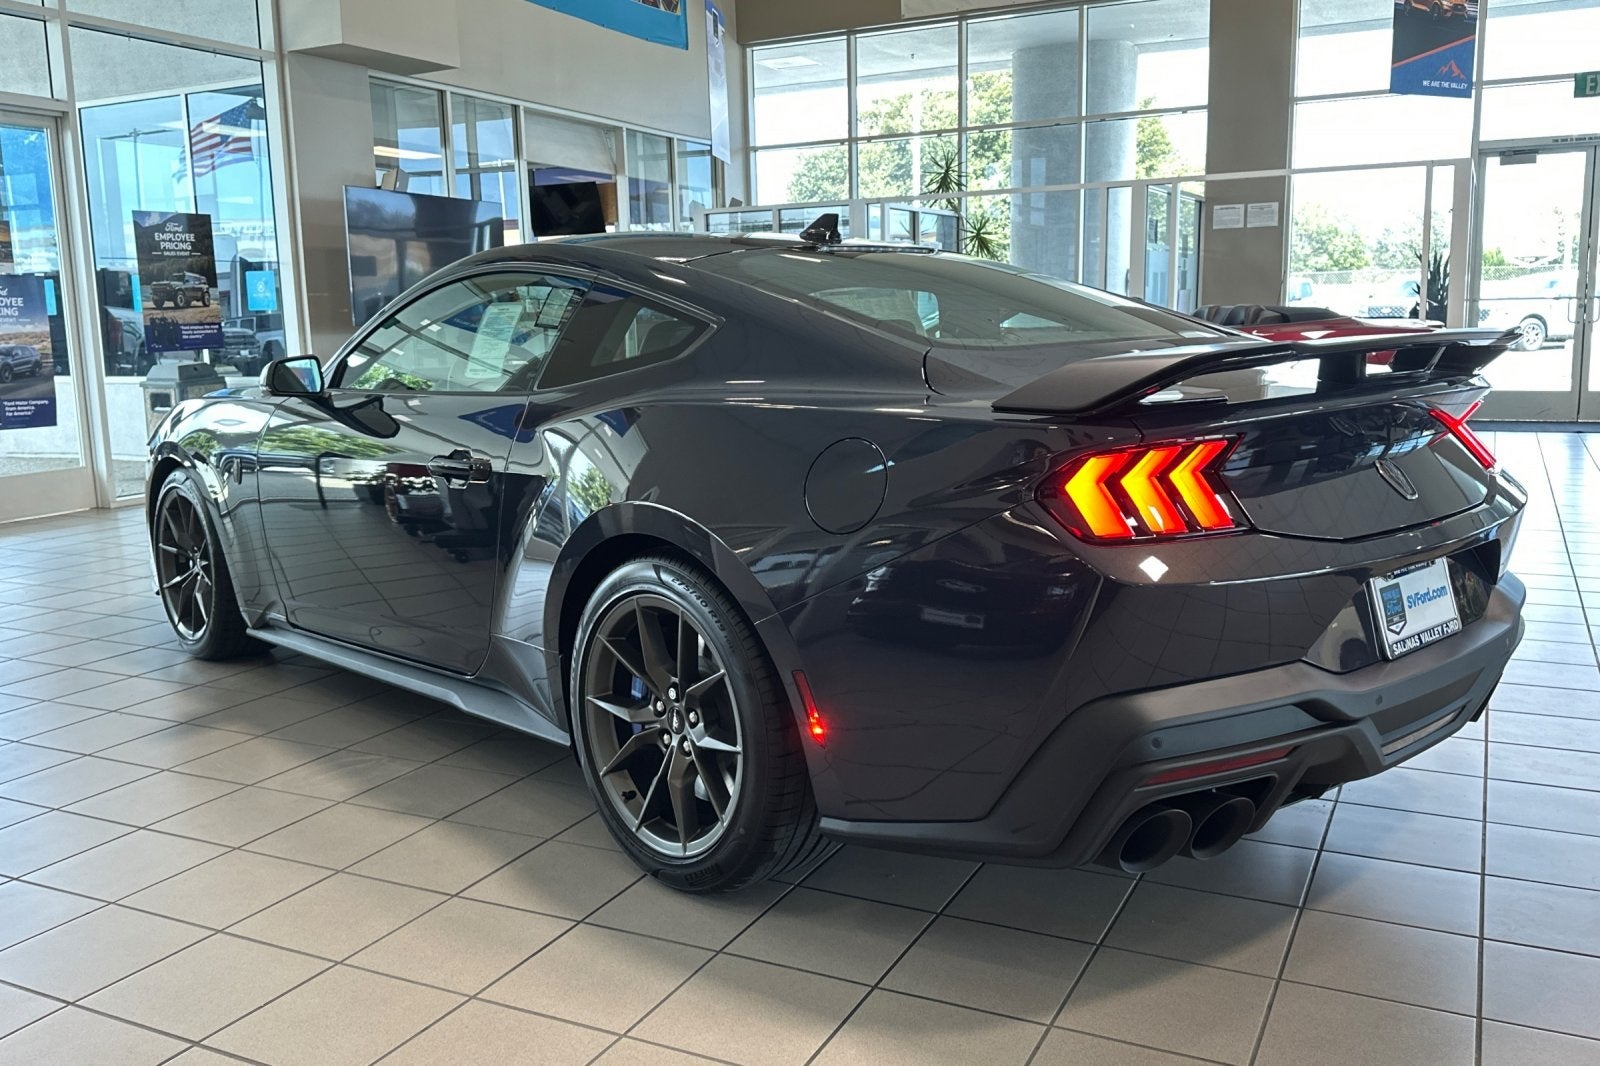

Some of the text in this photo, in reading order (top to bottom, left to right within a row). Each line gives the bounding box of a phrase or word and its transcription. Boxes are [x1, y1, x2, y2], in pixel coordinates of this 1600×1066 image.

[1430, 80, 1440, 88] ARE
[1450, 82, 1468, 90] VALLEY
[165, 222, 183, 232] Ford
[154, 232, 195, 242] EMPLOYEE
[160, 241, 192, 251] PRICING
[0, 307, 18, 316] ING
[671, 577, 708, 608] 275/40
[1406, 585, 1448, 609] SVFord.com
[1392, 634, 1420, 655] SALINAS
[1420, 625, 1443, 644] VALLEY
